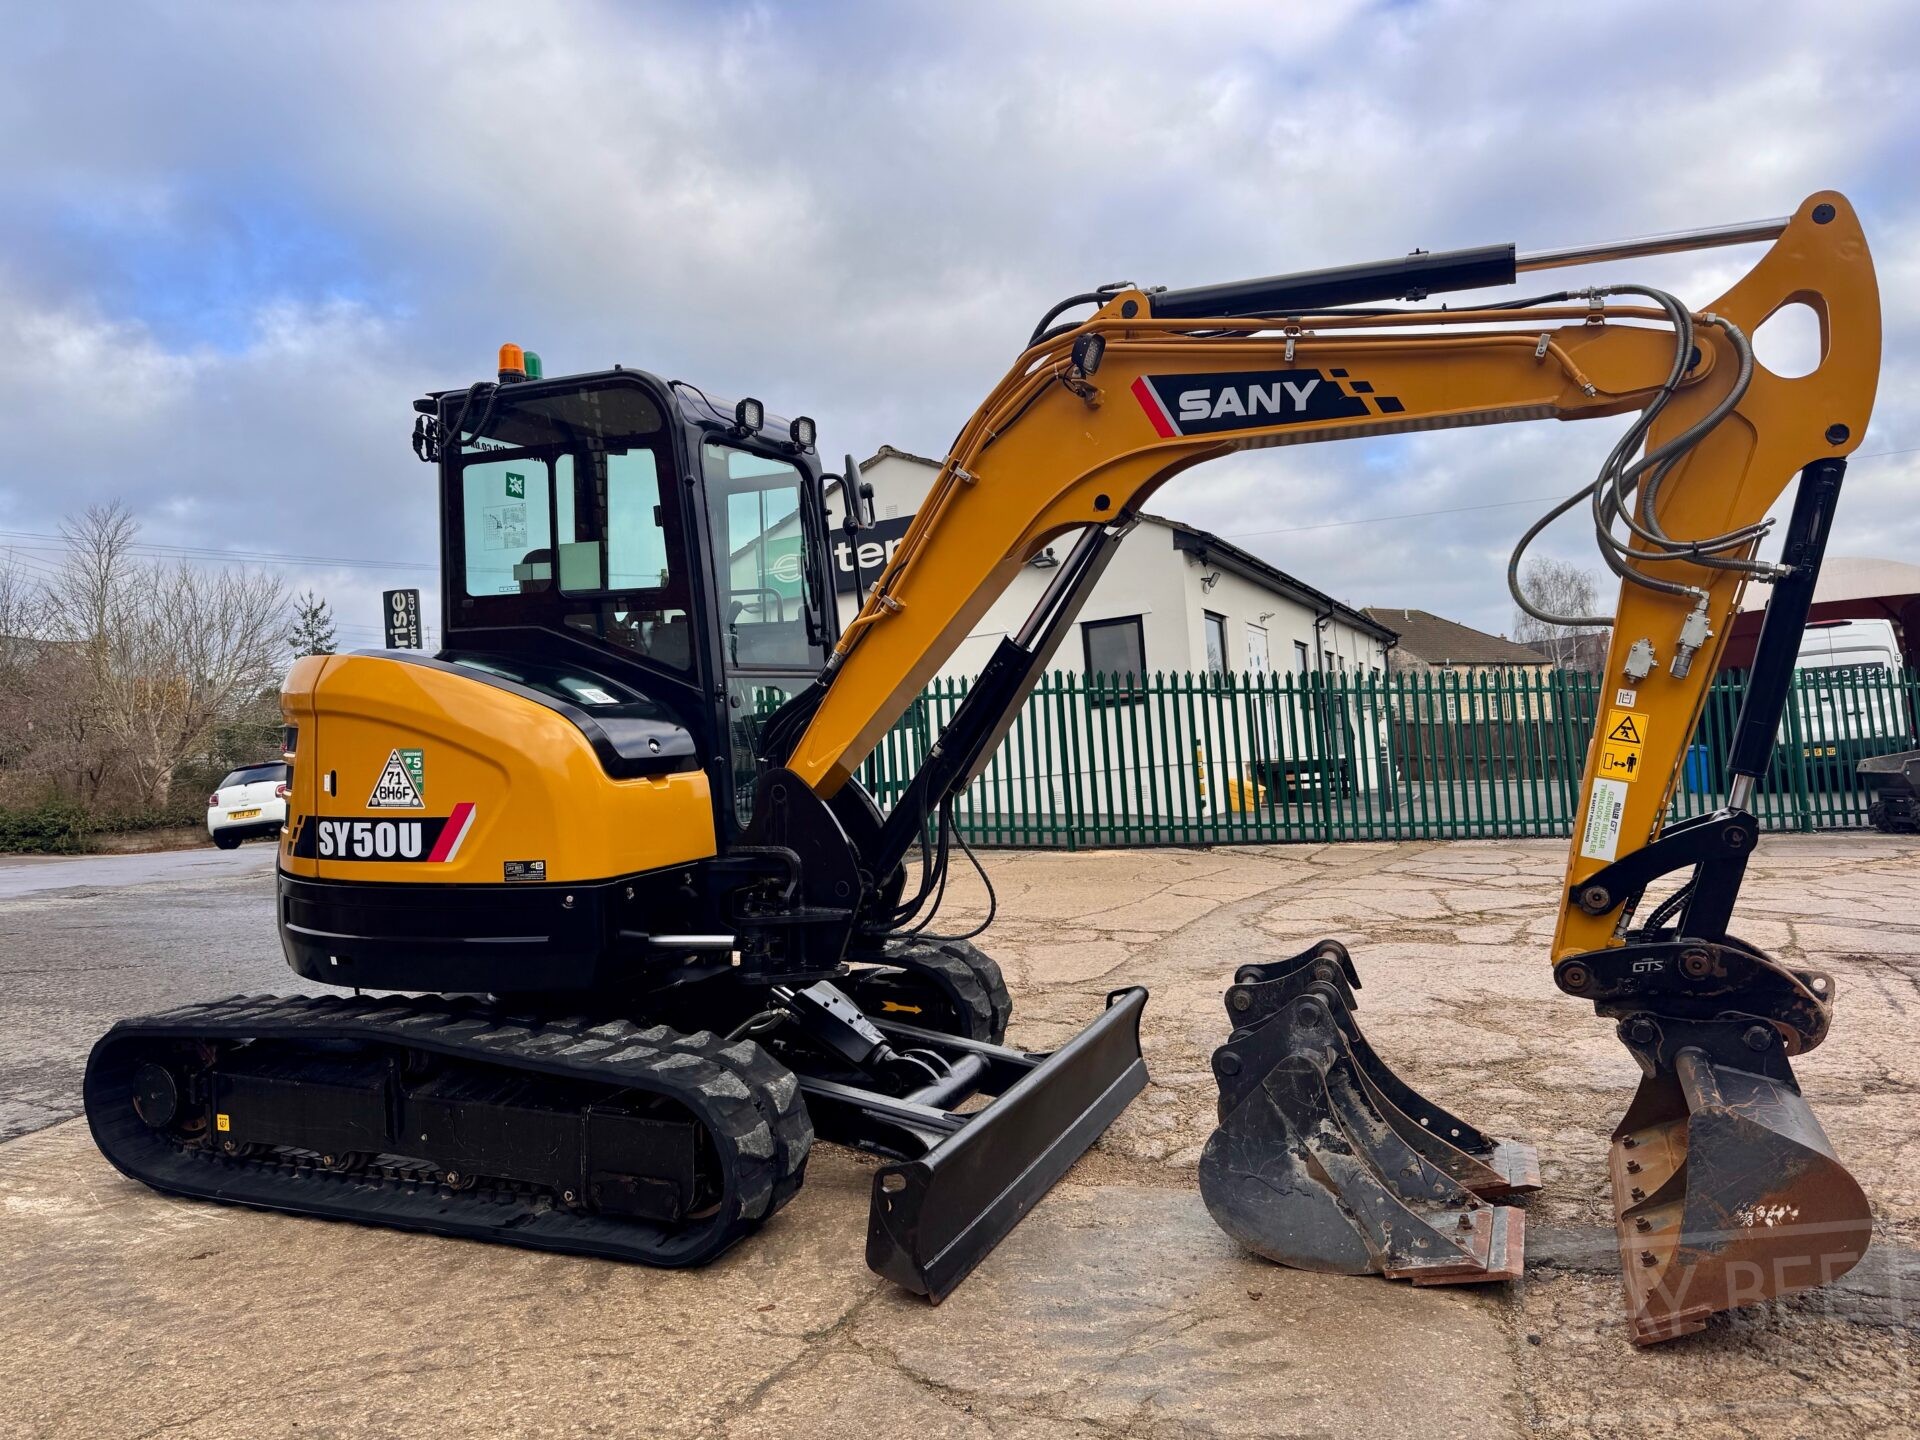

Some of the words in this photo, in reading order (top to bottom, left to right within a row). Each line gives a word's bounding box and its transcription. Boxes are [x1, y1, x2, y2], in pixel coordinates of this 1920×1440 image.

[1178, 378, 1321, 422] SANY
[390, 592, 408, 649] rise
[407, 592, 418, 650] rent-a-car
[387, 771, 402, 786] 71
[413, 757, 422, 769] 5
[379, 786, 411, 800] BH6F
[1595, 783, 1607, 820] TWINLOCK
[1603, 791, 1614, 822] GENUINE
[318, 820, 422, 859] SY50U
[1589, 821, 1600, 853] COUPLER
[1599, 823, 1608, 849] MILLER
[1632, 960, 1664, 973] GTS
